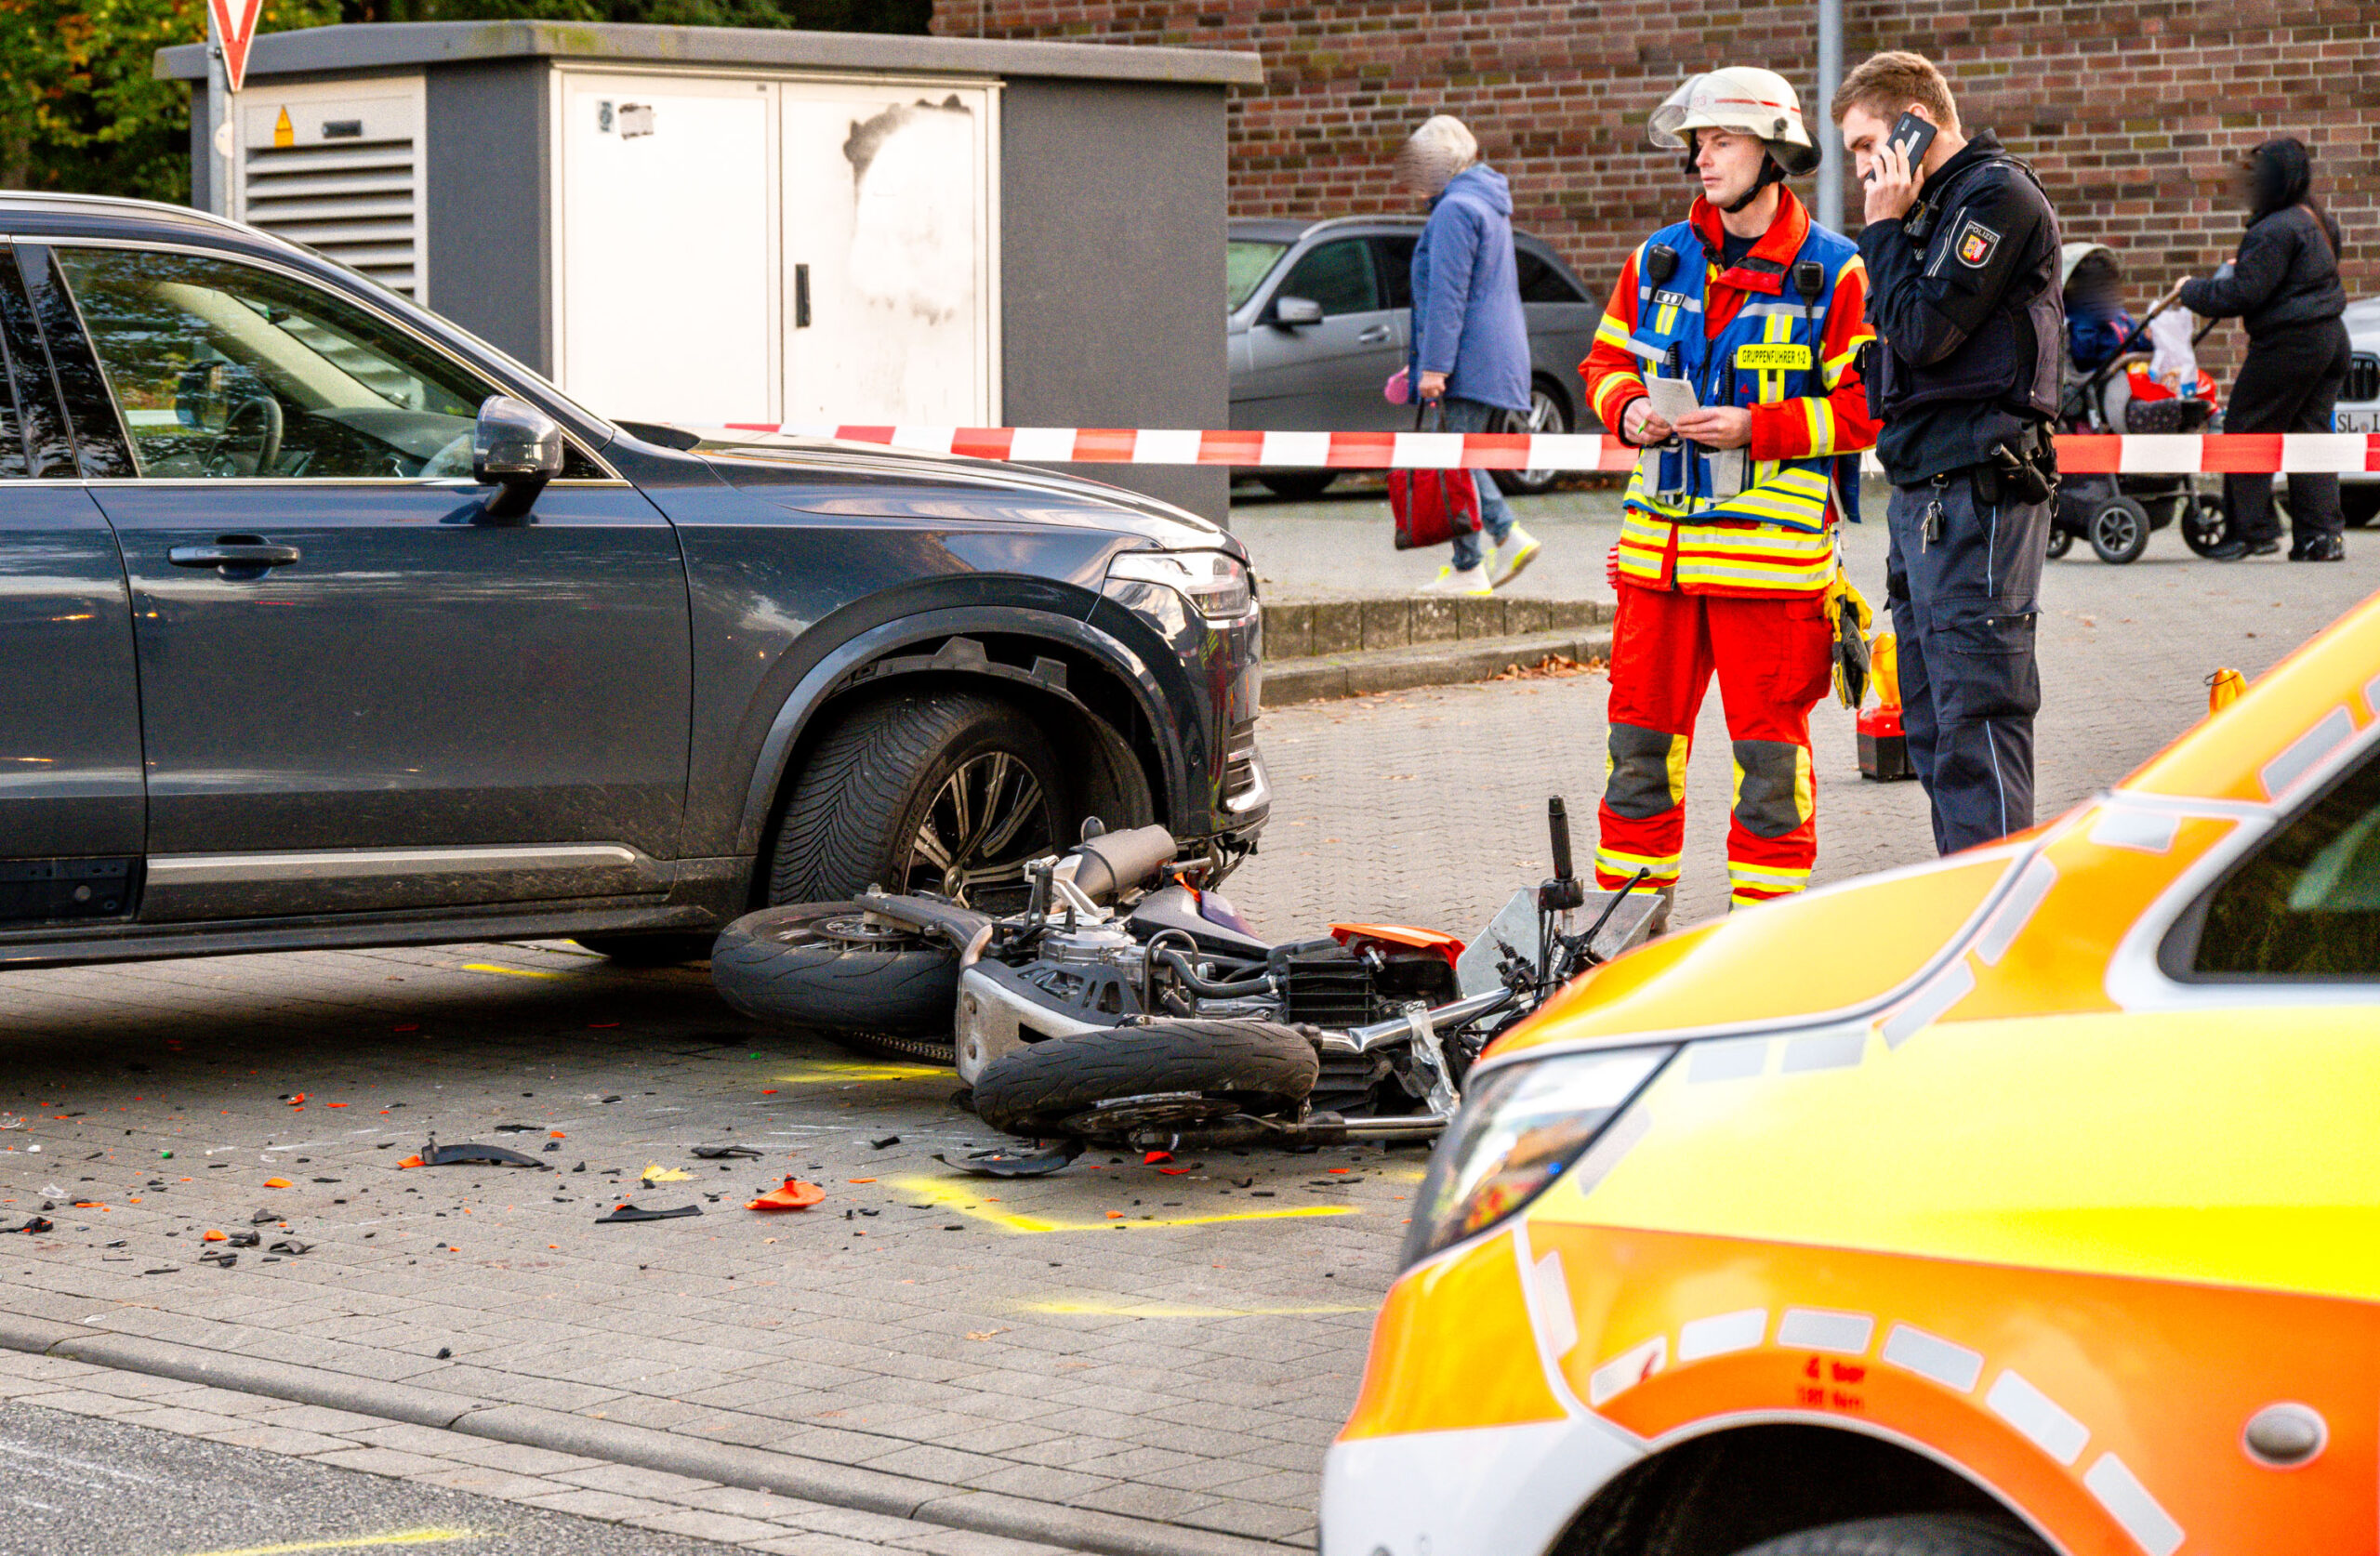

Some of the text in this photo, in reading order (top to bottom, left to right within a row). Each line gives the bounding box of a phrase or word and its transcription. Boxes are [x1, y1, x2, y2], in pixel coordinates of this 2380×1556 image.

[1967, 224, 1997, 244] POLIZEI
[1797, 350, 1806, 364] 1-2
[2337, 414, 2359, 433] SL
